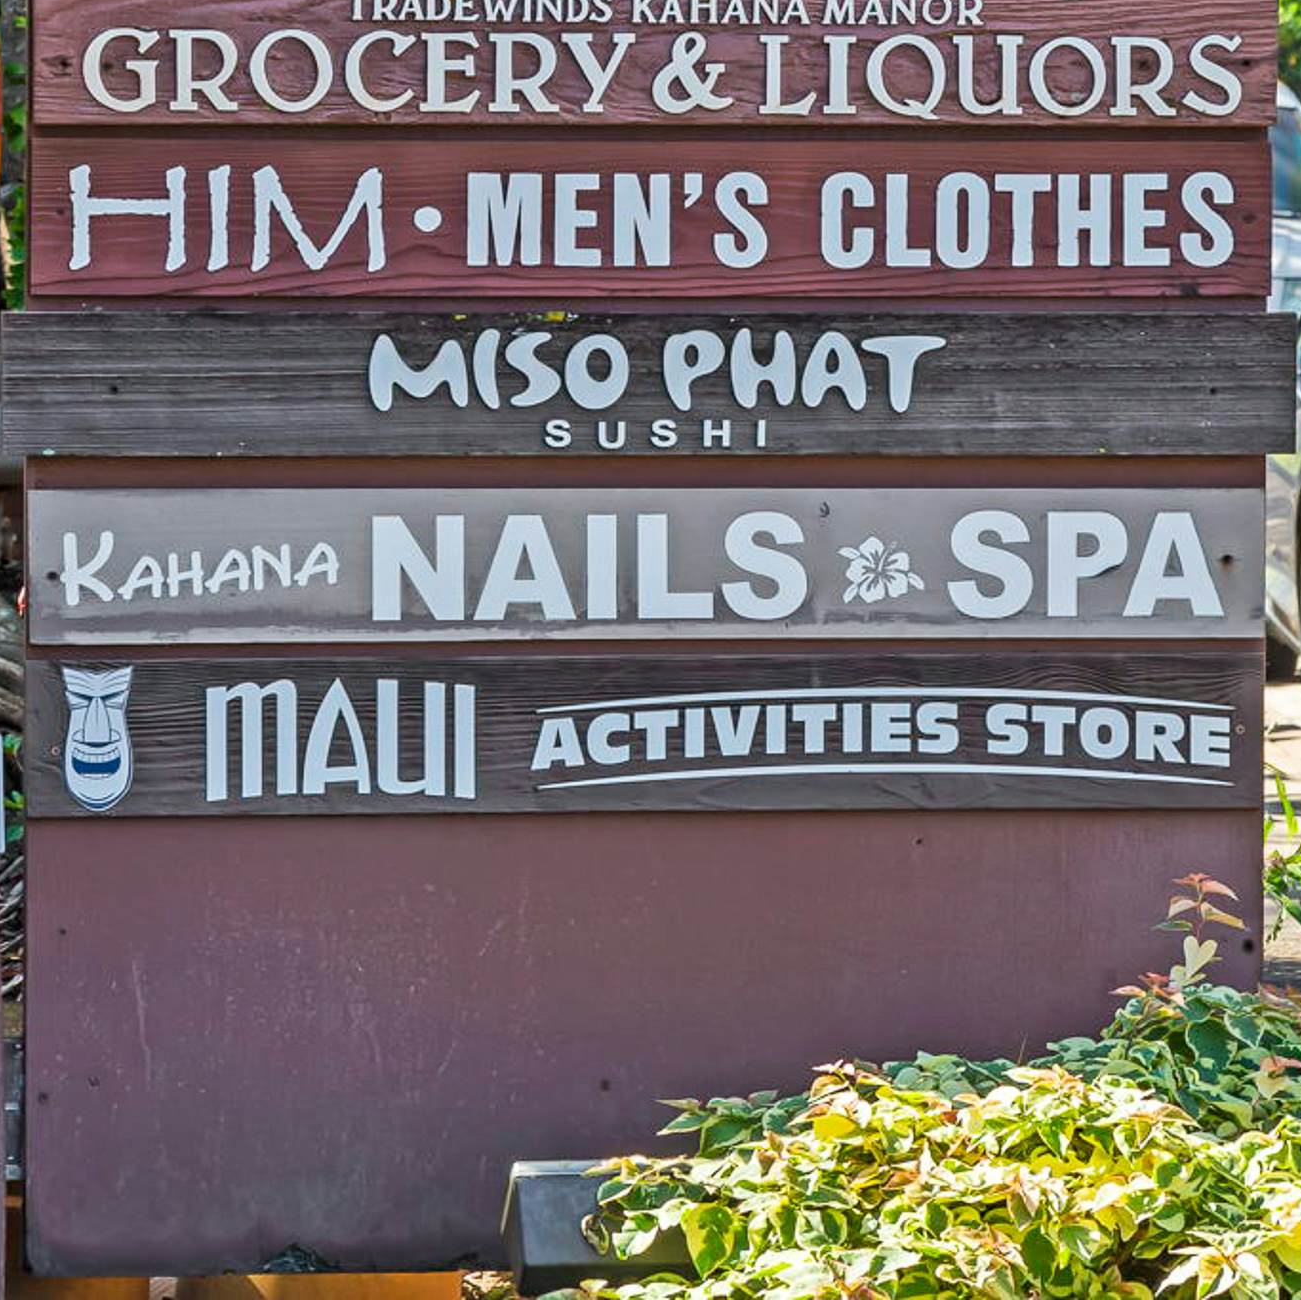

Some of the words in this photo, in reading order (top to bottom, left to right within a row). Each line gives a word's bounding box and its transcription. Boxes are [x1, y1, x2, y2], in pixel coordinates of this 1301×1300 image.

[81, 26, 637, 114] GROCERY
[651, 30, 734, 115] &
[757, 33, 1244, 121] LIQUORS
[68, 164, 387, 273] HIM
[466, 170, 770, 269] MEN'S
[819, 170, 1236, 270] CLOTHES
[367, 327, 631, 412] MISO
[662, 327, 948, 413] PHAT
[543, 418, 768, 449] SUSHI
[60, 528, 341, 607] KAHANA
[371, 511, 809, 621] NAILS
[947, 510, 1225, 620] SPA
[205, 677, 476, 803] MAUI
[530, 702, 960, 772] ACTIVITIES
[986, 703, 1232, 768] STORE
